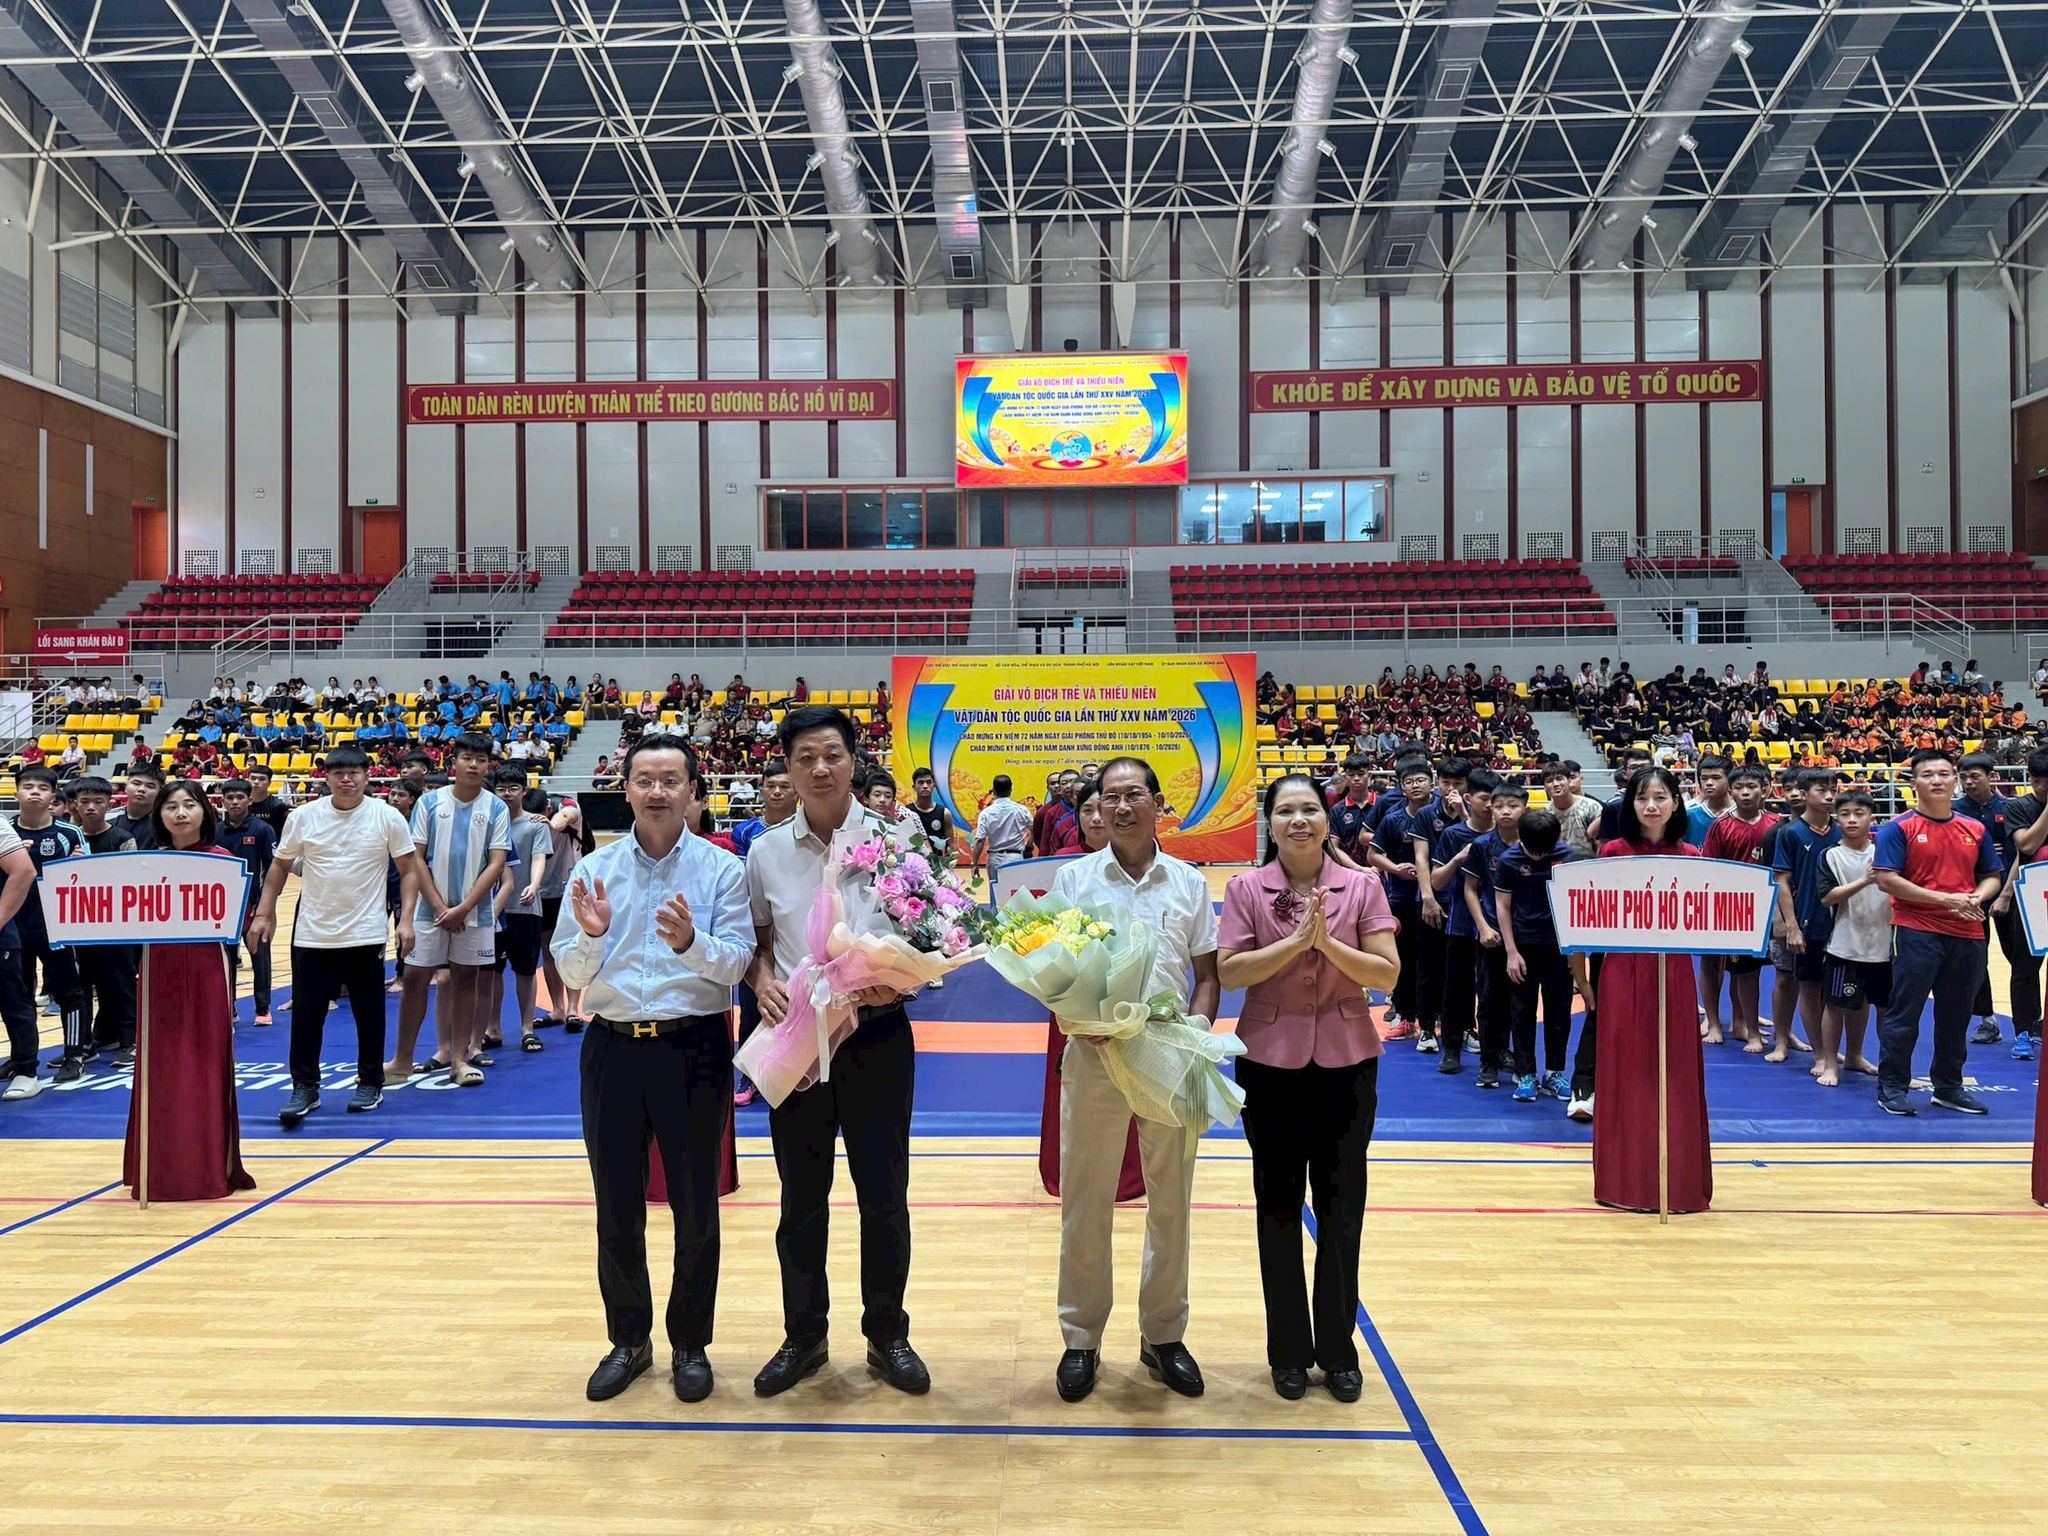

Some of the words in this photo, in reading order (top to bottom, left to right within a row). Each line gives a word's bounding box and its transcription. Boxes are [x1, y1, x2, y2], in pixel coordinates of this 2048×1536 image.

[1057, 391, 1069, 399] GIA
[1273, 377, 1334, 403] KHỎE
[1342, 374, 1373, 401] ĐỂ
[1380, 376, 1427, 400] XÂY
[1434, 377, 1500, 402] DỰNG
[1508, 373, 1539, 397] VÀ
[1547, 370, 1594, 396] BẢO
[1602, 372, 1630, 399] VỆ
[1639, 367, 1669, 394] TỔ
[1676, 366, 1741, 396] QUỐC
[422, 392, 461, 416] TOÀN
[467, 392, 498, 415] DÂN
[503, 391, 533, 414] RÈN
[538, 390, 585, 419] LUYỆN
[590, 390, 630, 414] THÂN
[635, 385, 663, 413] THỂ
[668, 392, 706, 412] THEO
[711, 390, 764, 412] GƯƠNG
[768, 388, 799, 412] BÁC
[804, 385, 825, 412] HỒ
[829, 388, 844, 412] VĨ
[848, 392, 874, 416] ĐẠI
[38, 634, 50, 647] LỐI
[53, 637, 75, 647] SANG
[77, 634, 99, 646] KHÁN
[102, 634, 115, 646] ĐÀI
[118, 636, 123, 646] D
[994, 685, 1014, 700] GIẢI
[1018, 687, 1031, 700] VÔ
[1034, 688, 1058, 703] ĐỊCH
[1062, 685, 1080, 700] TRẺ
[1083, 685, 1096, 699] VÀ
[1100, 684, 1128, 699] THIẾU
[1131, 686, 1156, 699] NIÊN
[955, 709, 976, 726] VẬT
[977, 709, 998, 722] DÂN
[1001, 709, 1020, 726] TỘC
[1024, 707, 1051, 723] QUỐC
[1054, 711, 1072, 721] GIA
[1075, 707, 1094, 721] LẦN
[1098, 709, 1118, 721] THỨ
[1121, 710, 1140, 721] XXV
[1144, 709, 1167, 721] NĂM
[1171, 710, 1196, 720] 2026
[56, 874, 112, 923] TỈNH
[122, 877, 171, 922] PHÚ
[179, 883, 226, 928] THỌ
[1568, 881, 1618, 928] THÀNH
[1623, 877, 1654, 929] PHỐ
[1658, 877, 1678, 930] HỒ
[1684, 883, 1708, 931] CHÍ
[1714, 892, 1754, 931] MINH
